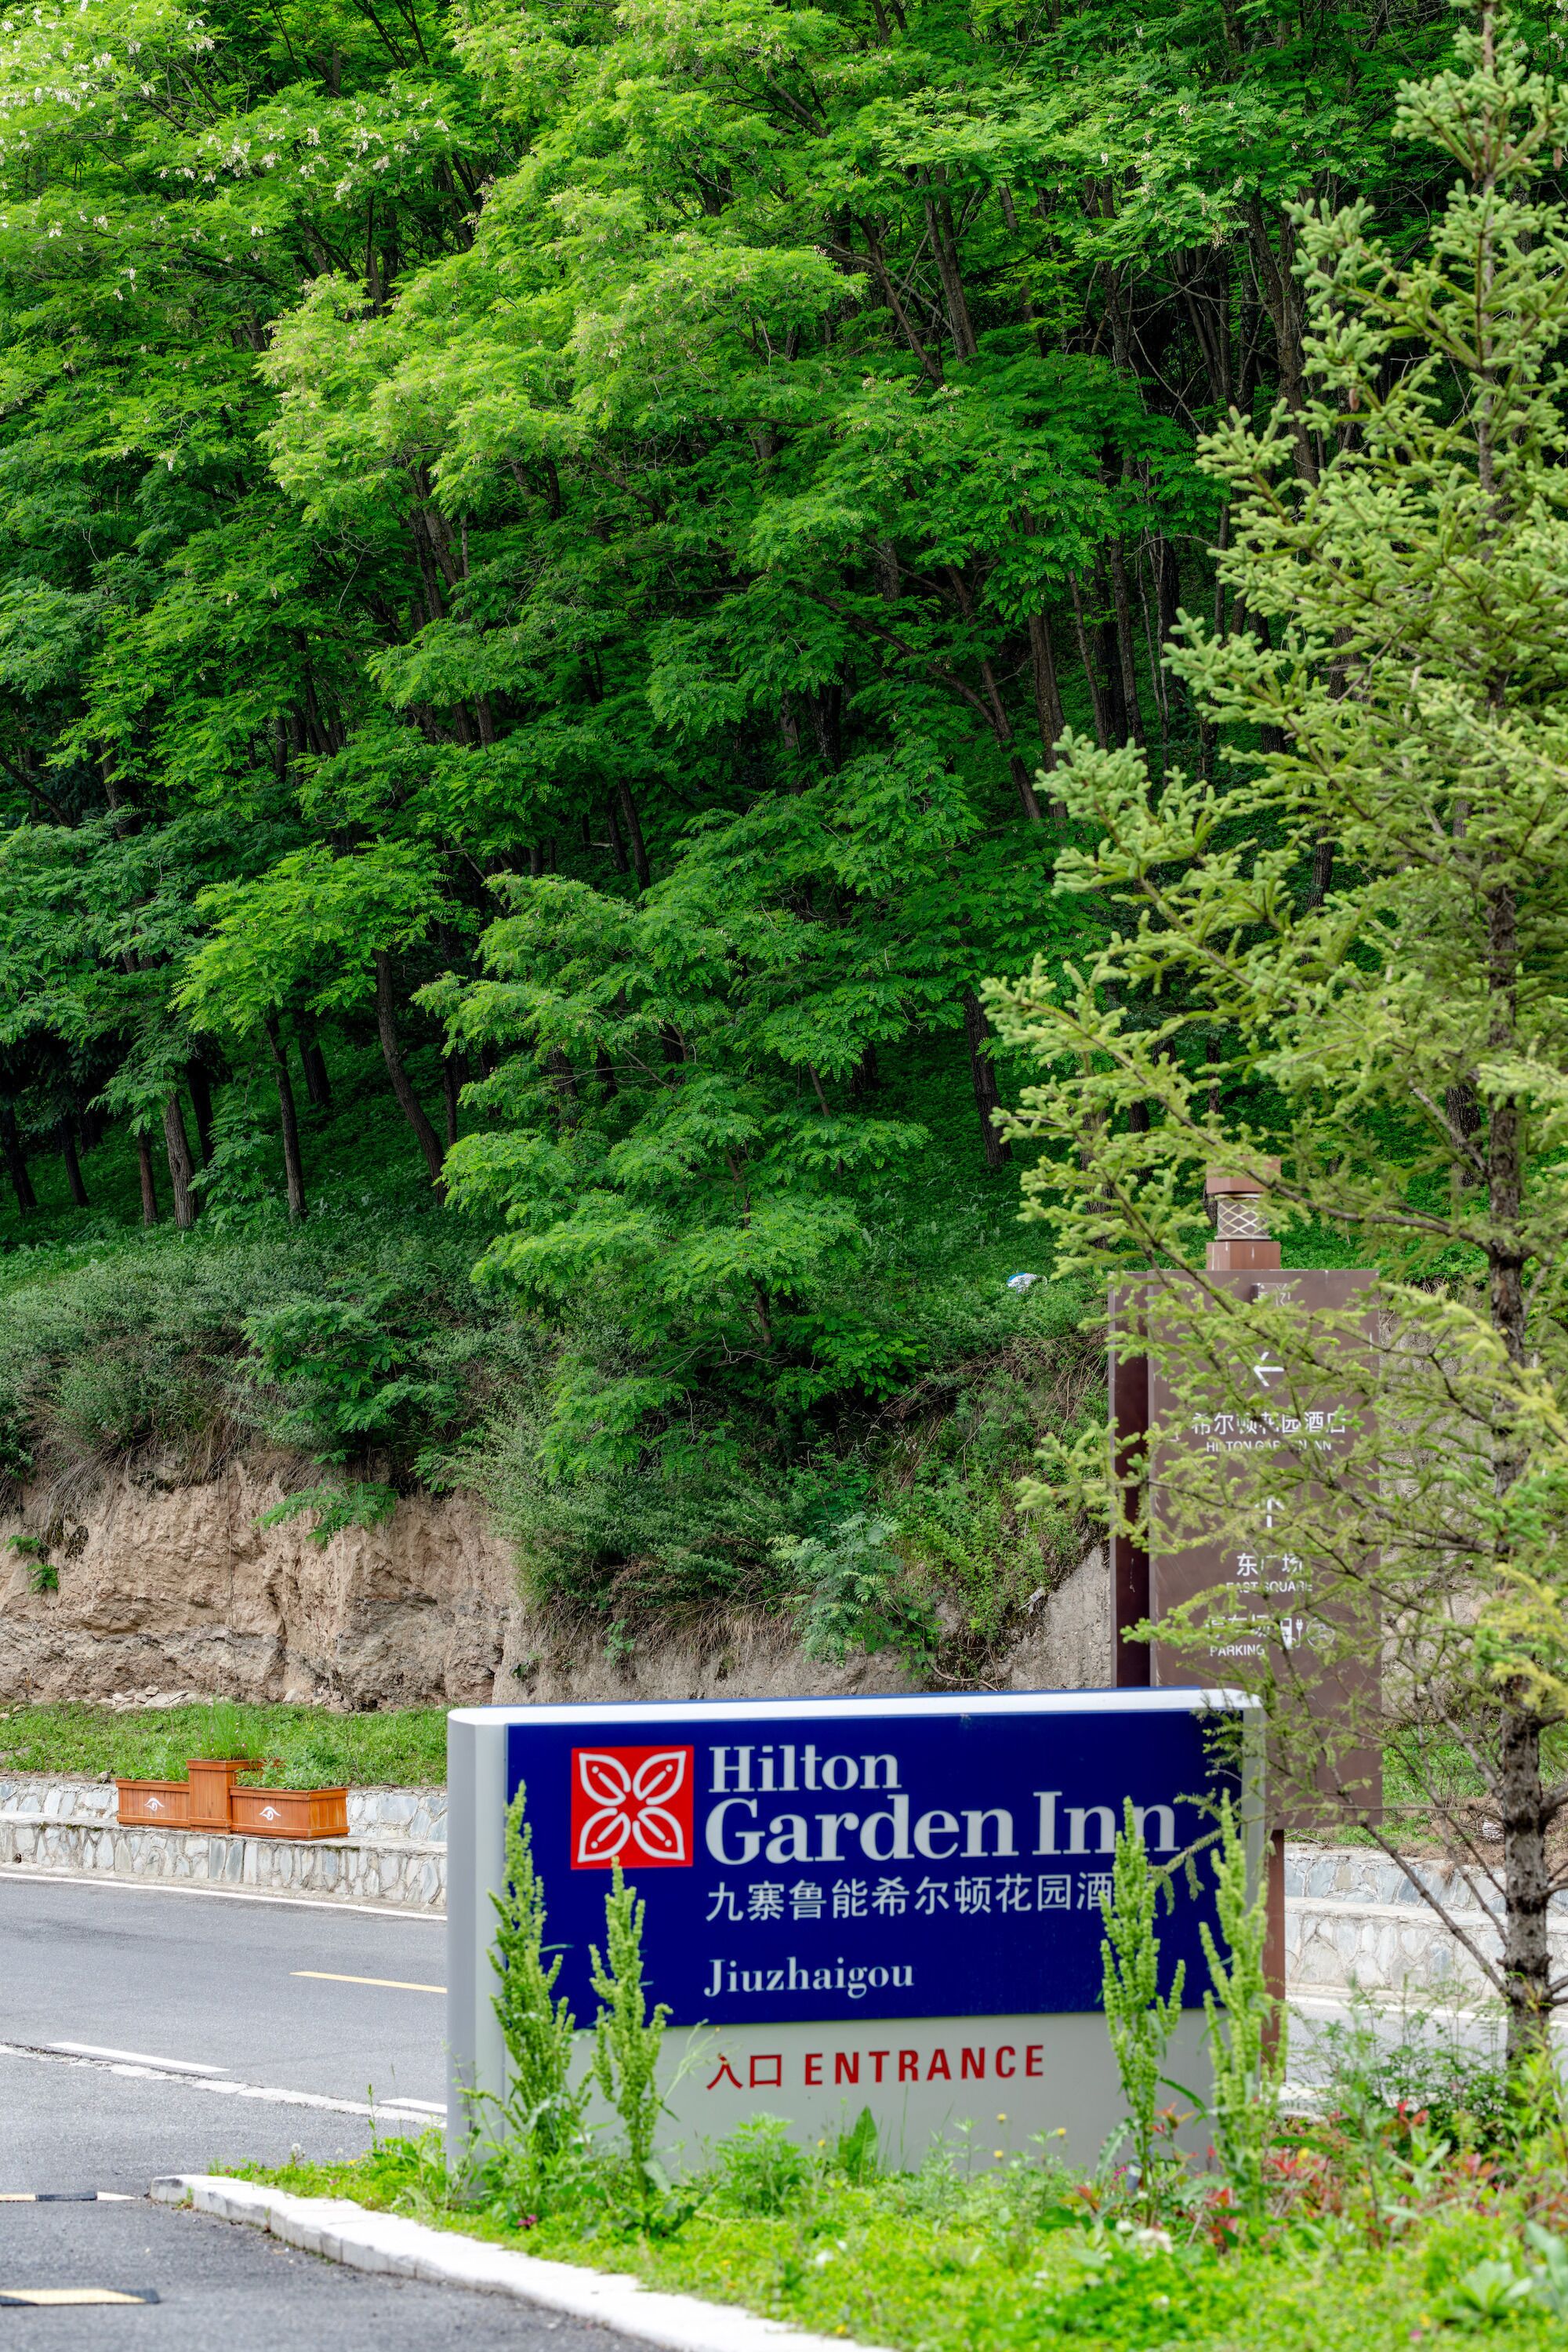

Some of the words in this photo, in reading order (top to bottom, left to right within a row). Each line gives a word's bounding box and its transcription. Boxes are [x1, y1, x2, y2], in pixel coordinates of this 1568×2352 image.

[1206, 1440, 1252, 1452] HITON
[1210, 1644, 1265, 1657] PARKING
[708, 1744, 902, 1792] Hilton
[706, 1794, 1019, 1865] Garden
[1032, 1791, 1181, 1856] Inn
[706, 1871, 1153, 1922] 九寨鲁能希尔顿花园酒
[703, 1956, 914, 1999] Jiuzhaigou
[706, 2052, 782, 2090] 入口
[804, 2045, 1044, 2085] ENTRANCE
